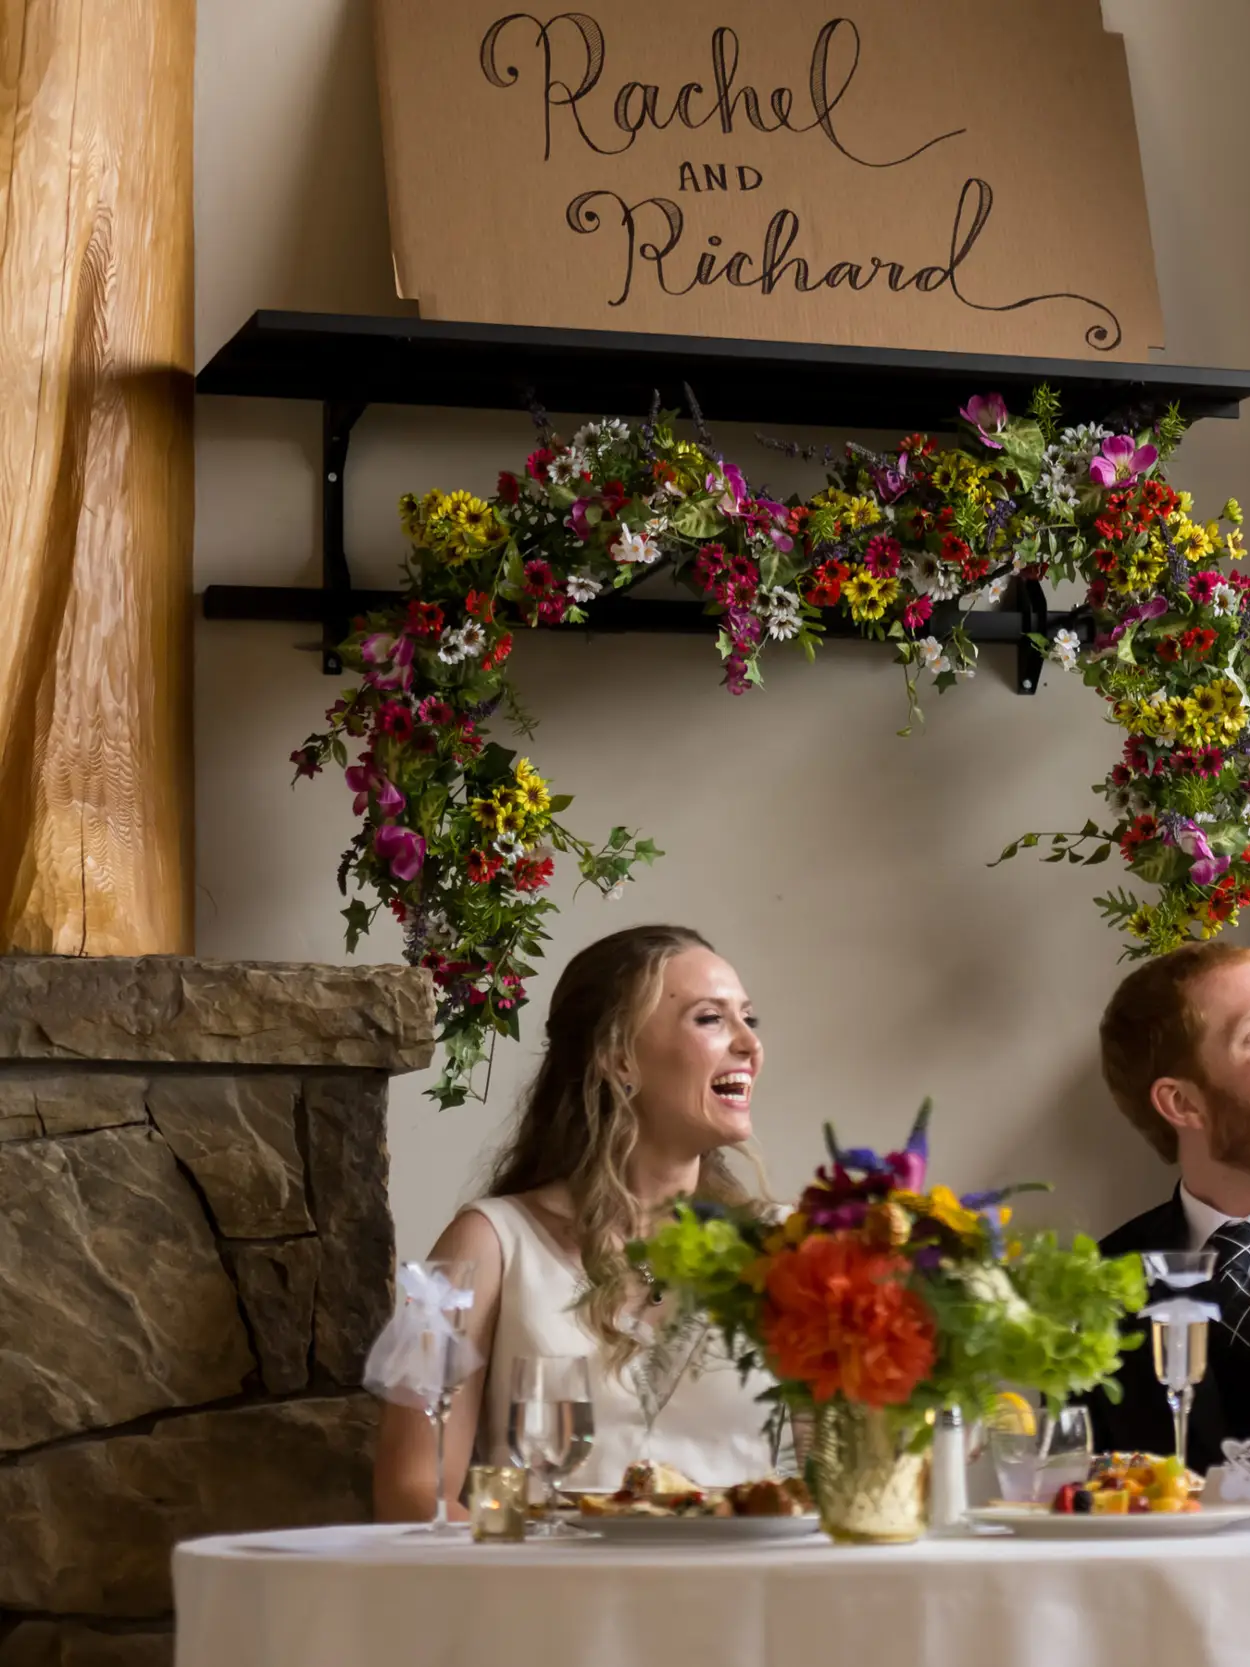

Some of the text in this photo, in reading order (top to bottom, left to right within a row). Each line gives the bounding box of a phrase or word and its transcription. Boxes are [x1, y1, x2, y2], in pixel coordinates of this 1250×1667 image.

[480, 12, 967, 167] Rachel
[679, 162, 763, 193] AND
[566, 178, 1122, 351] Richard
